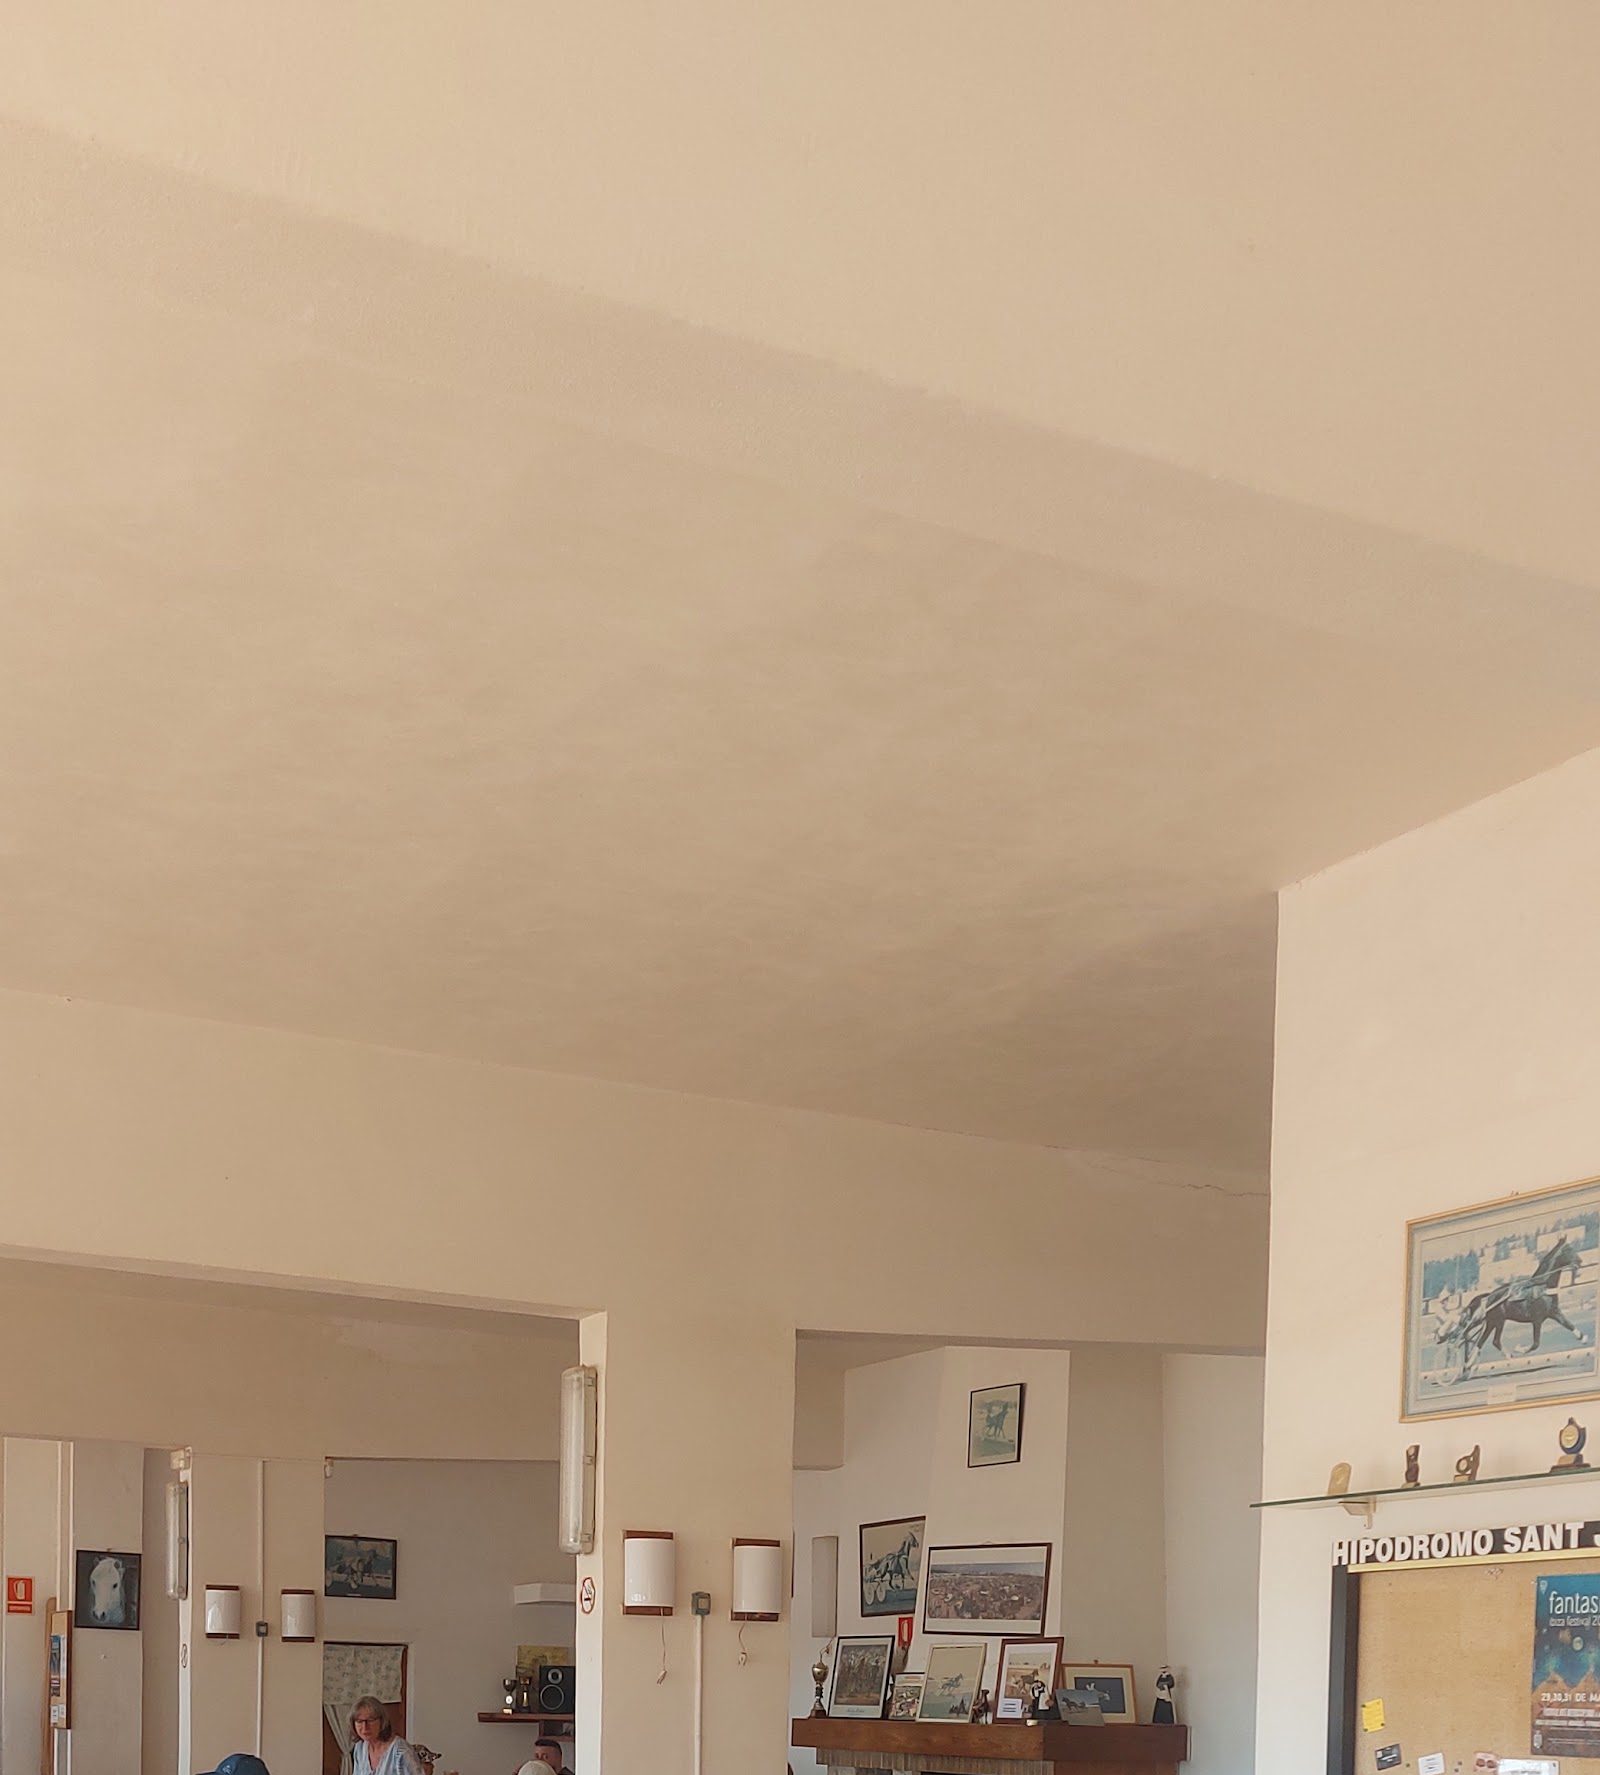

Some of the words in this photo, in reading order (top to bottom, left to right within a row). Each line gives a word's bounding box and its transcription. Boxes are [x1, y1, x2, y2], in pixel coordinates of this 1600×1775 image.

[1332, 1529, 1493, 1565] HIPODROMO
[1504, 1521, 1584, 1553] SANT
[1549, 1590, 1600, 1614] fantas
[1576, 1692, 1587, 1702] DE
